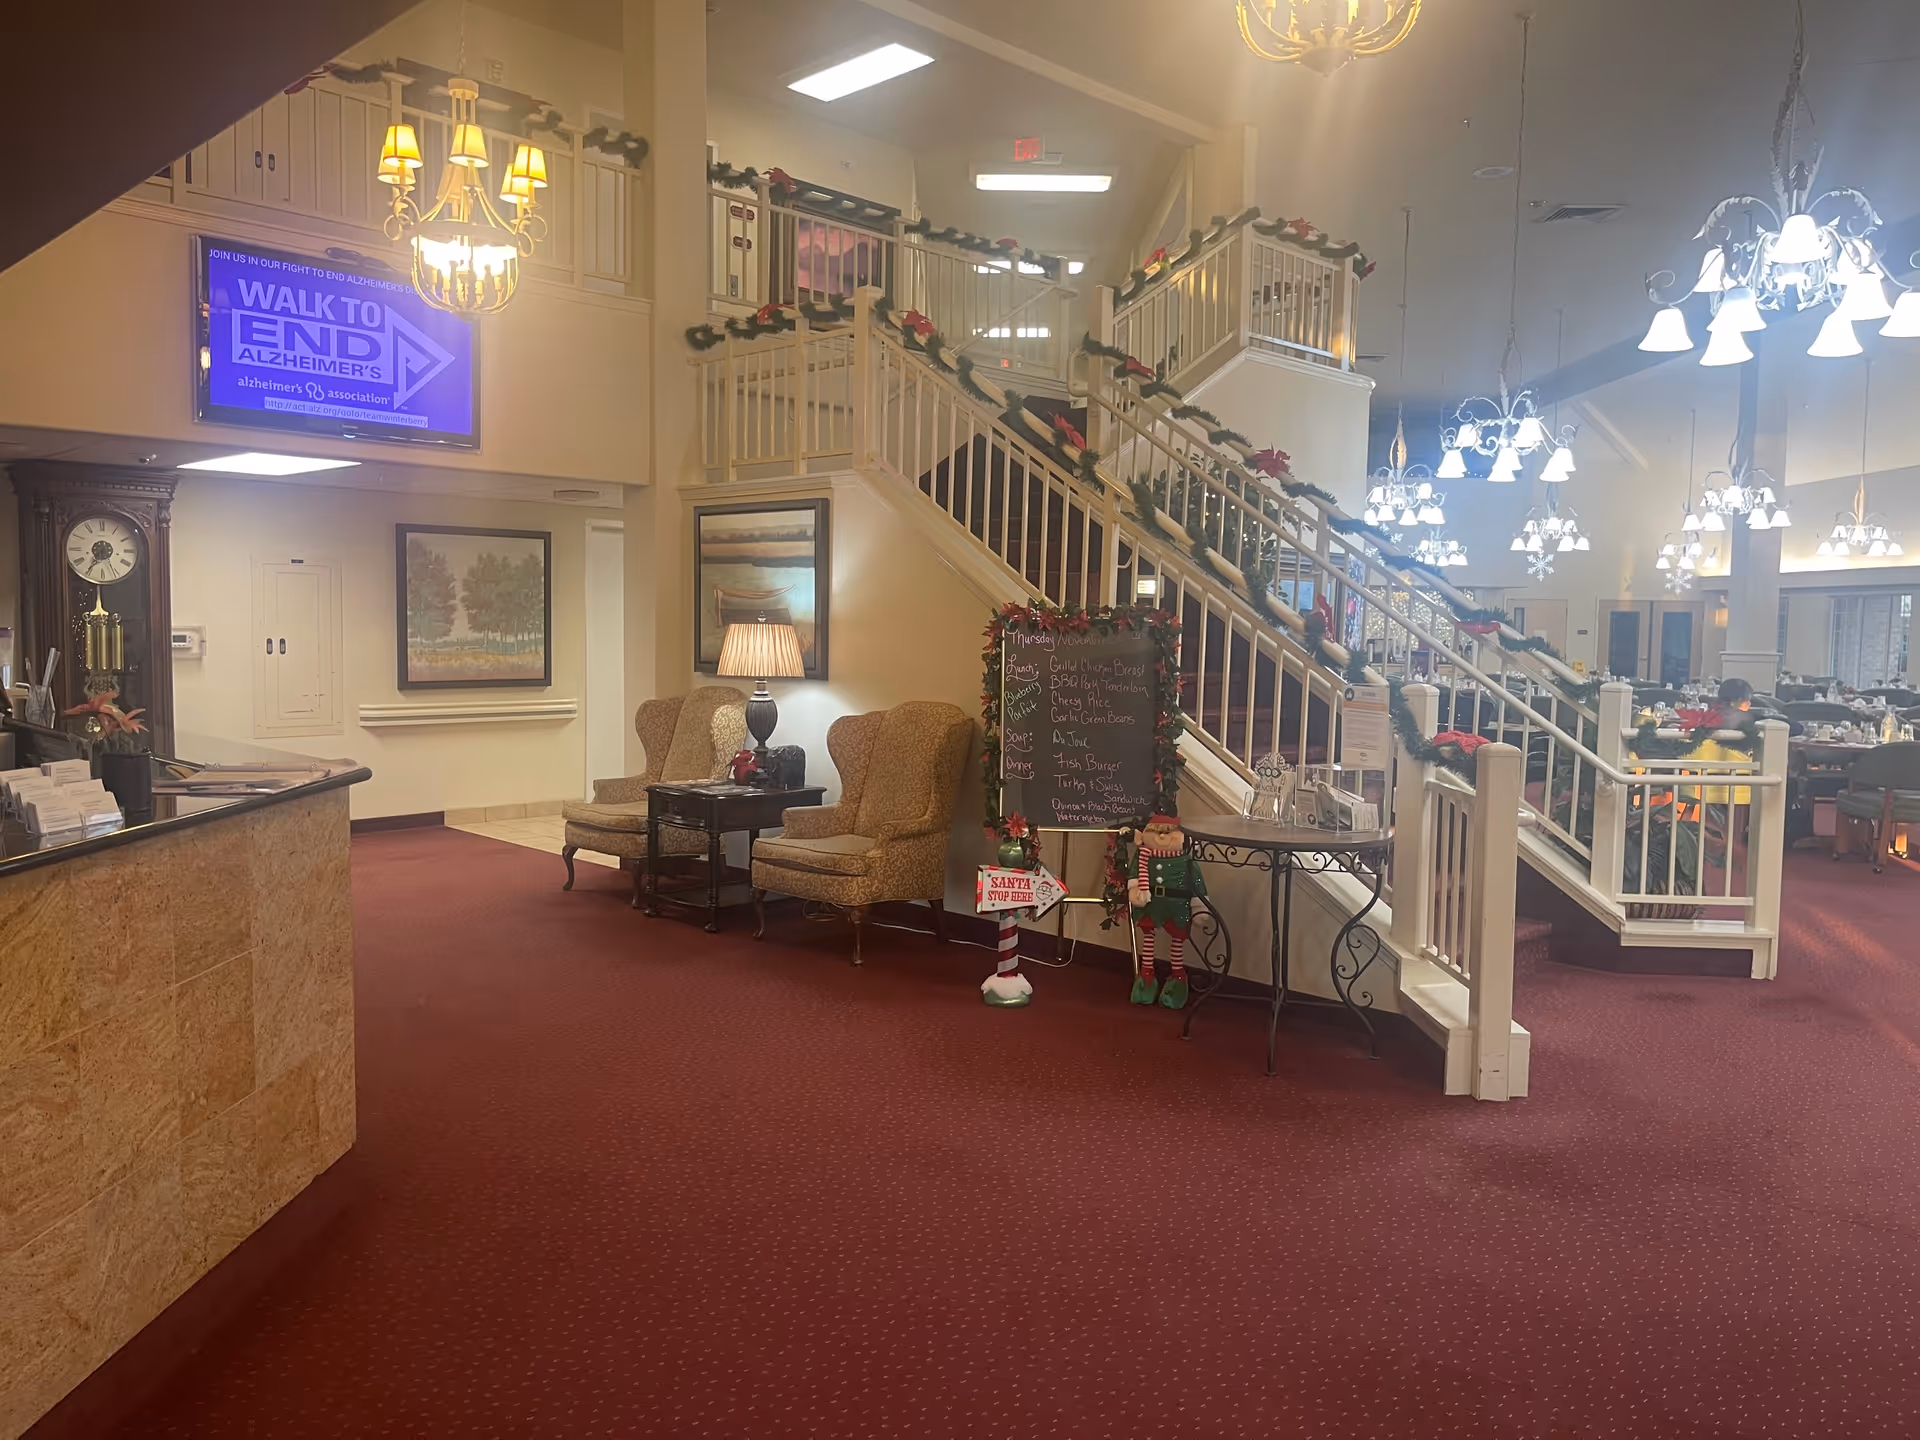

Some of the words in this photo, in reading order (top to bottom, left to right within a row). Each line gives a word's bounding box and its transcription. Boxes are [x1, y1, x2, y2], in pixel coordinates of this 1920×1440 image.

[209, 249, 230, 260] JOIN
[233, 253, 246, 263] US
[248, 256, 258, 265] IN
[260, 259, 280, 269] OUR
[283, 262, 310, 275] FIGHT
[312, 268, 324, 278] TO
[326, 271, 344, 281] END
[347, 275, 404, 293] ALZHEIMER'S
[238, 278, 336, 320] WALK
[340, 296, 381, 328] TO
[239, 312, 382, 362] END
[238, 347, 382, 379] ALZHEIMER'S
[237, 376, 303, 394] alzheimer's
[328, 390, 388, 405] association
[1006, 629, 1055, 651] Thursday
[1113, 658, 1145, 677] Breast
[1049, 673, 1079, 689] BBQ
[1053, 752, 1082, 771] Fish
[1085, 753, 1122, 779] Burger
[1096, 776, 1123, 792] Swiss
[1103, 792, 1151, 805] Sandwich
[991, 876, 1031, 890] SANTA
[987, 890, 1010, 902] STOP
[1011, 891, 1034, 902] HERE
